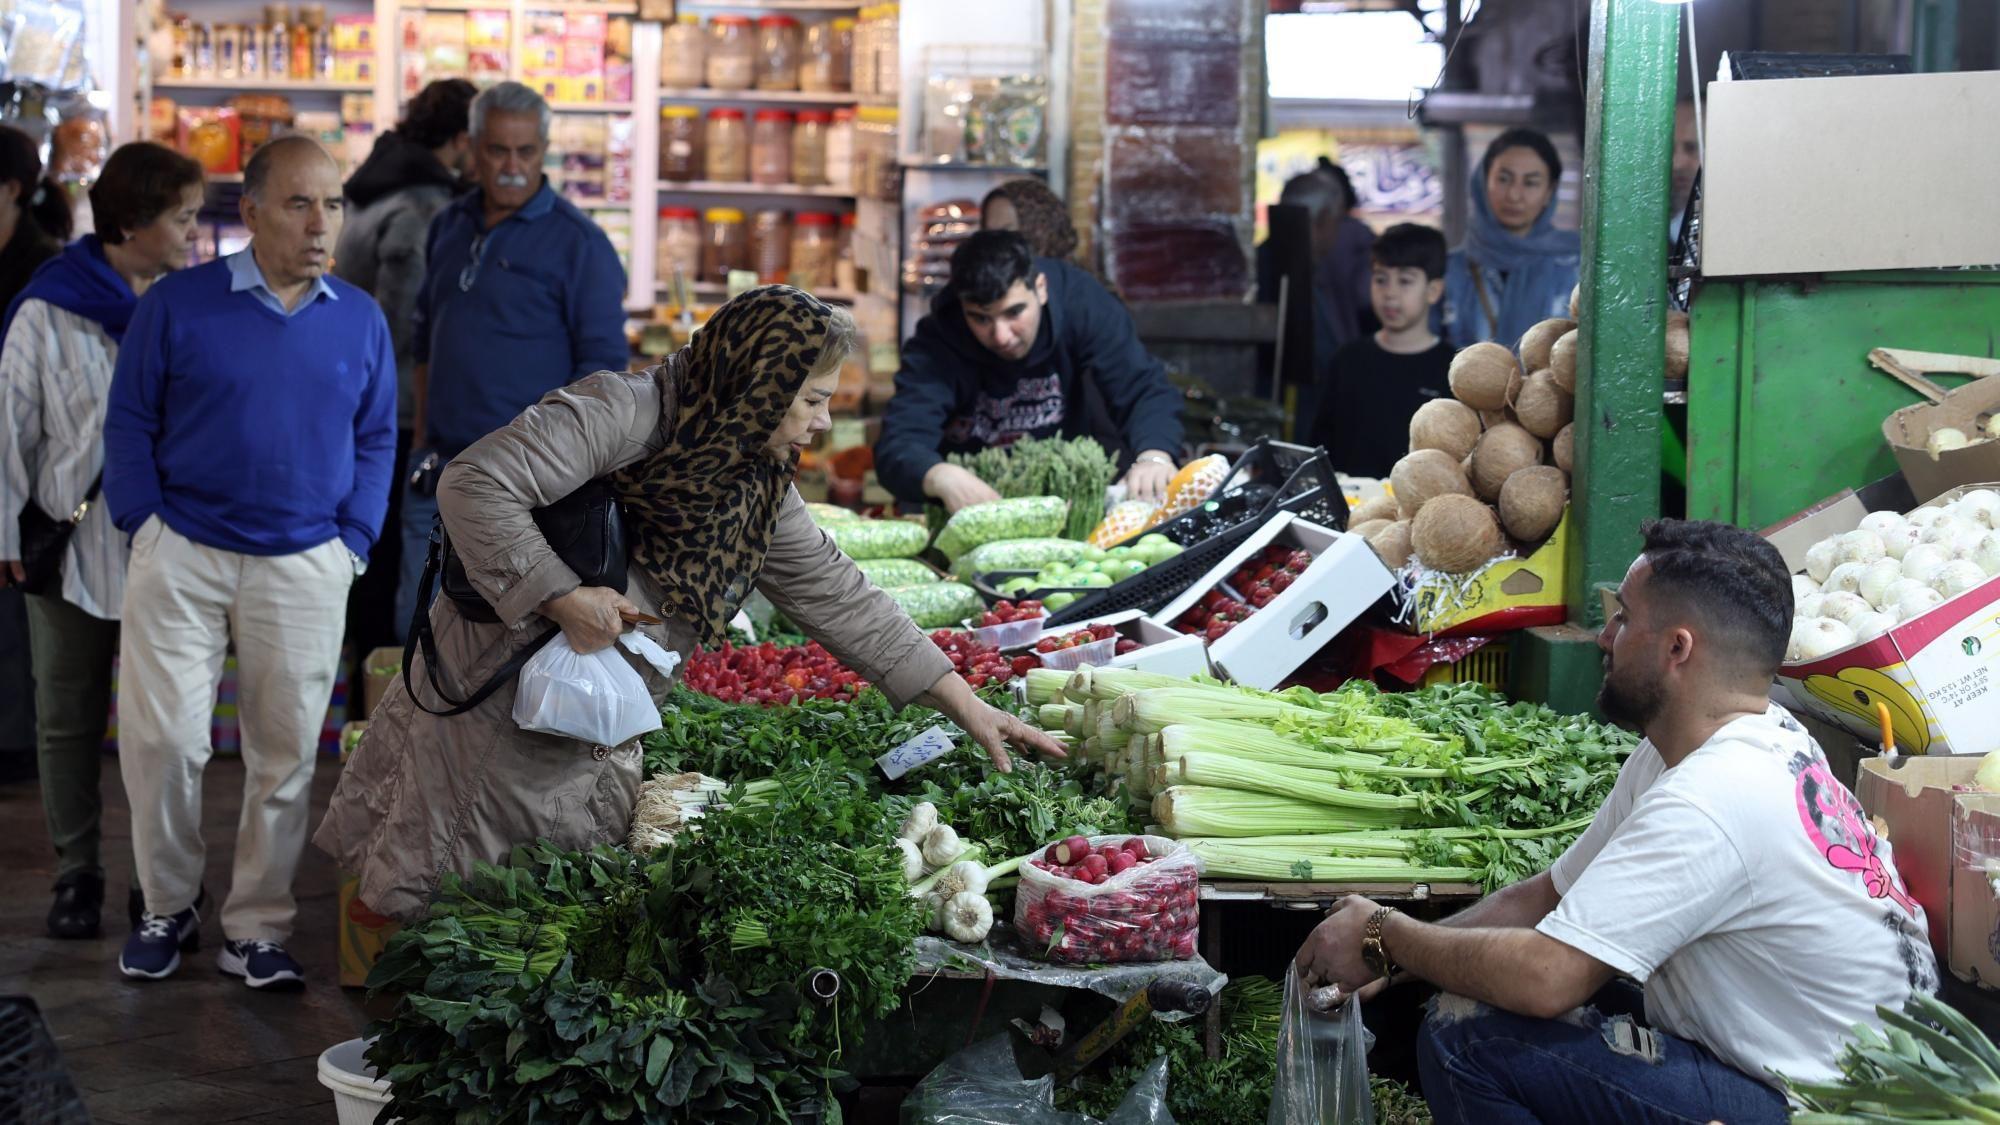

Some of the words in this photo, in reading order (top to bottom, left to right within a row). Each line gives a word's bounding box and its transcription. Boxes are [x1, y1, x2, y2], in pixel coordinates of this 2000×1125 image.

[1972, 666, 1988, 678] NET
[1941, 682, 1957, 693] 13.5
[1958, 684, 1971, 695] OR
[1966, 685, 1988, 702] KEEP
[1953, 697, 1963, 708] AT
